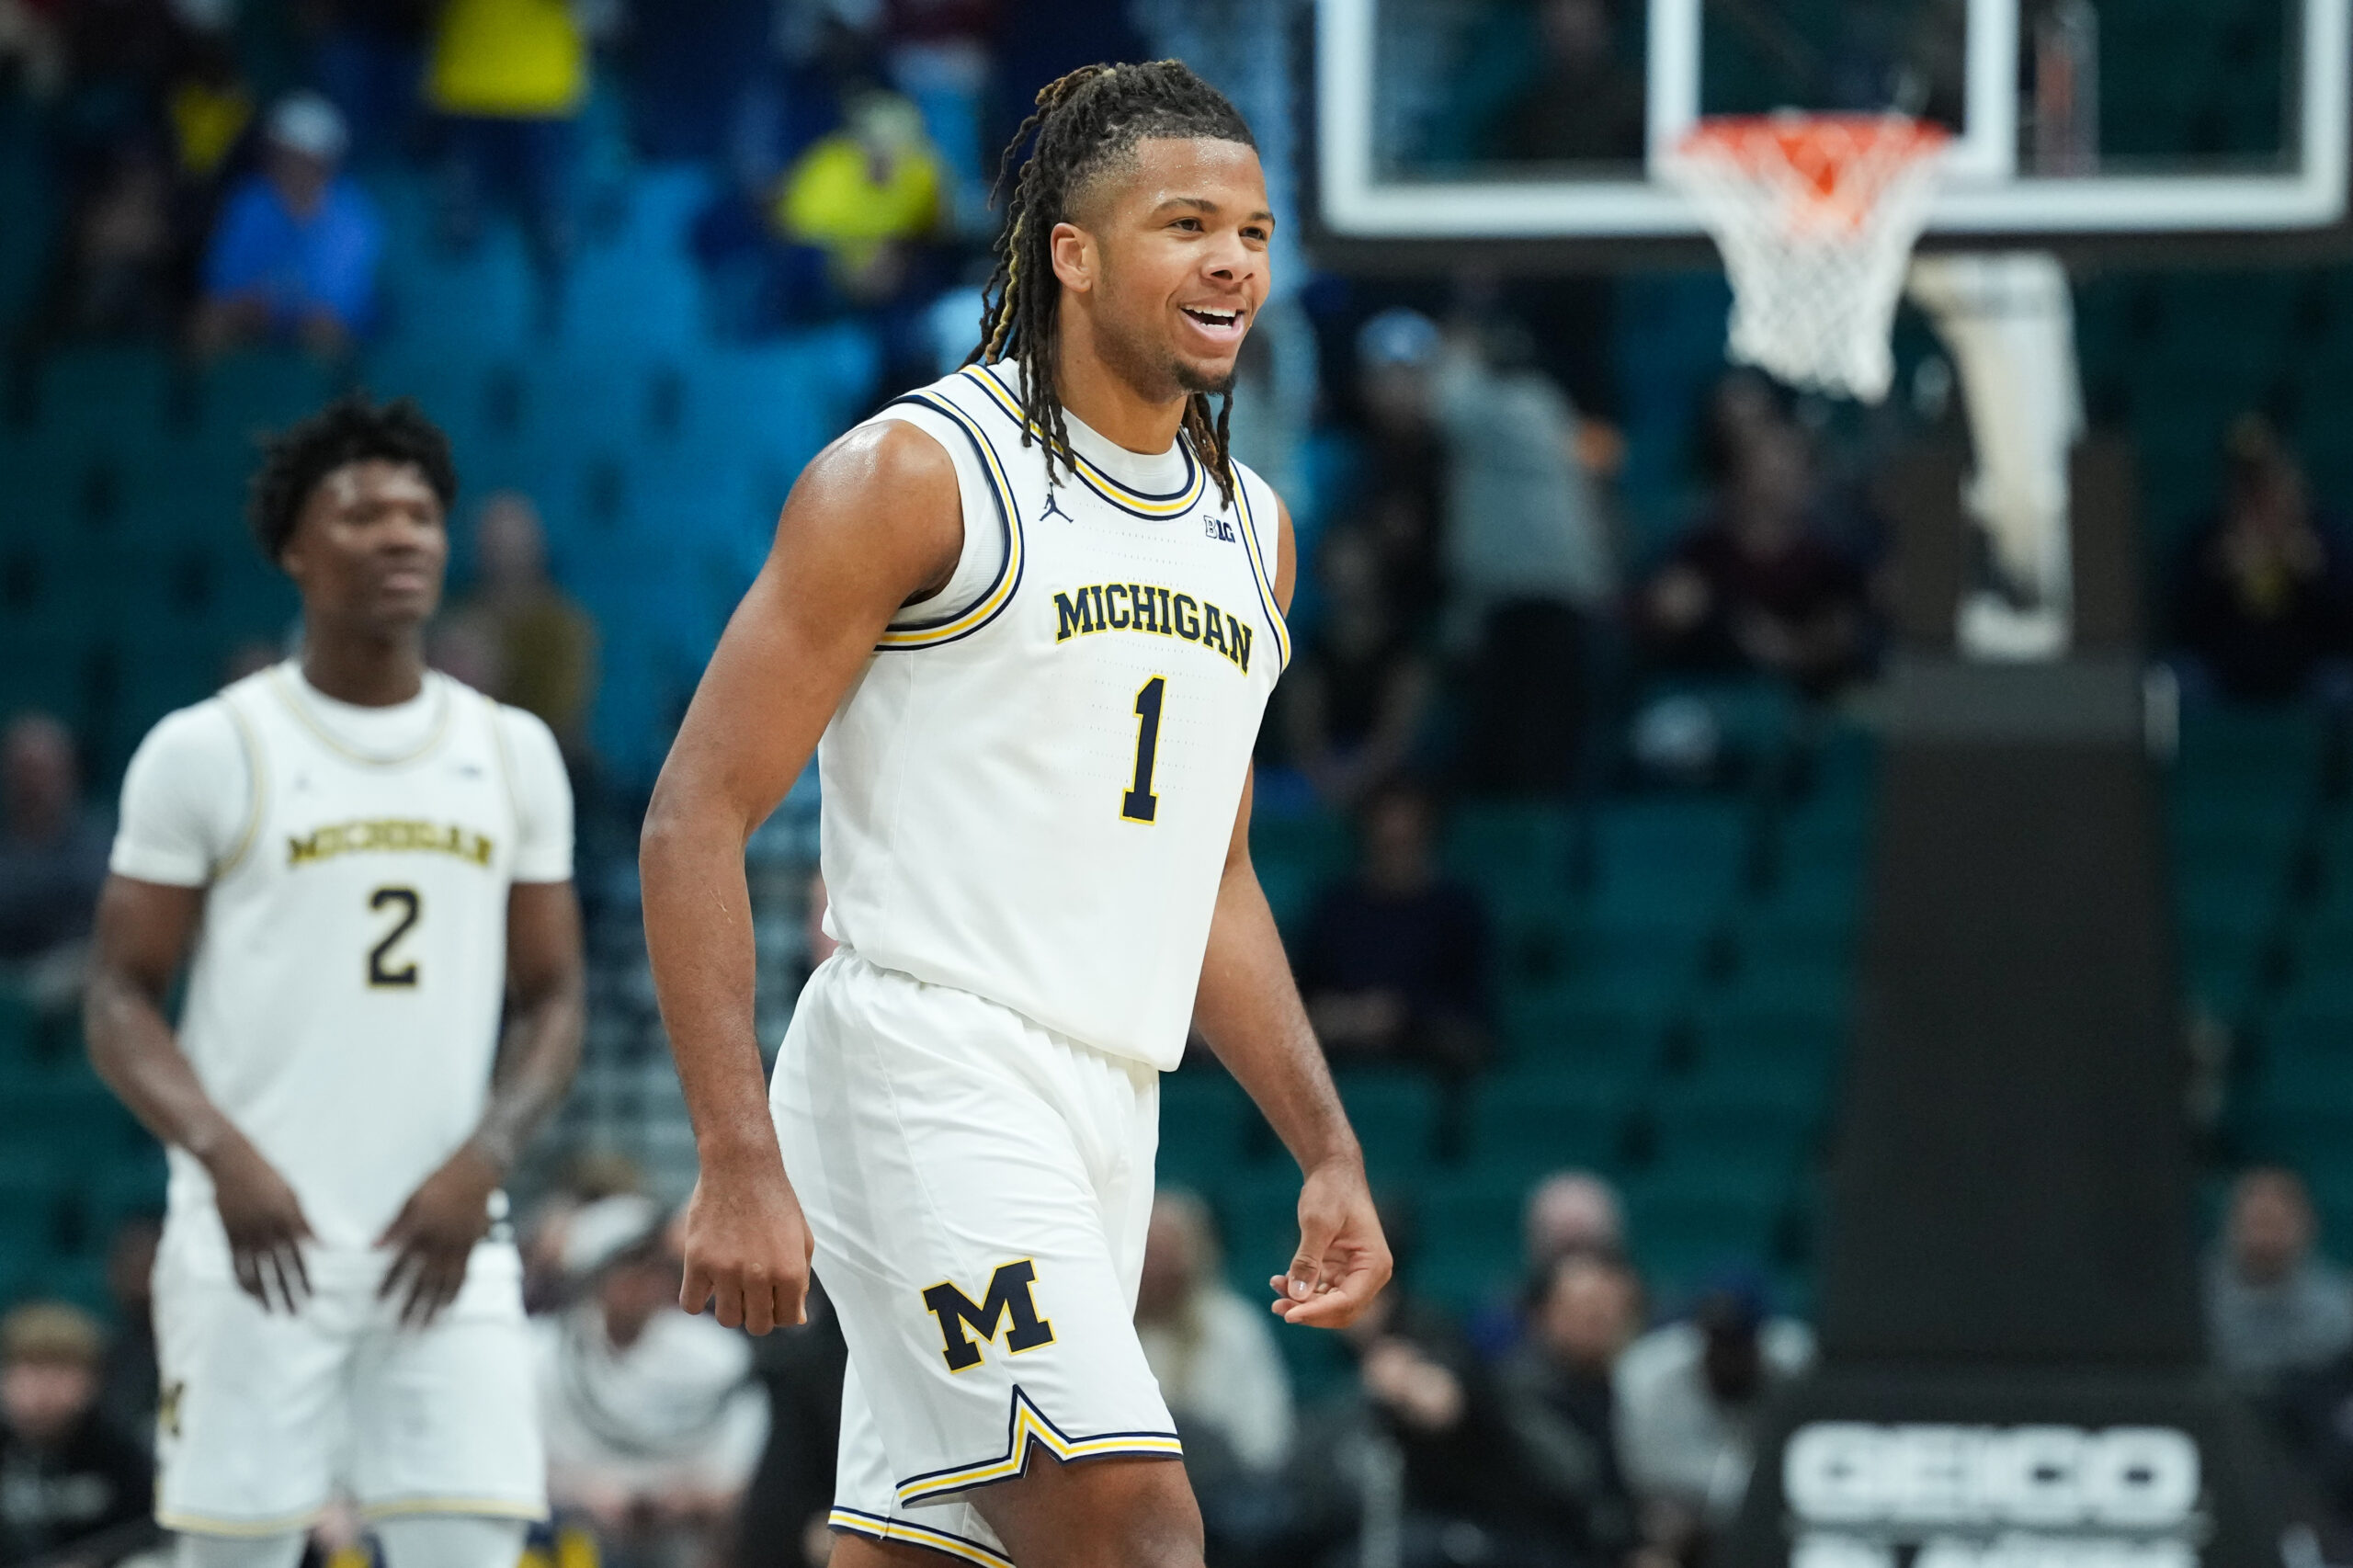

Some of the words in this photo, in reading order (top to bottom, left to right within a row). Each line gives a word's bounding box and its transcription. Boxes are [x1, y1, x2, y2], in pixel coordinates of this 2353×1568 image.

[1052, 584, 1253, 676] MICHIGAN
[1120, 674, 1166, 825] 1
[366, 886, 422, 989] 2
[920, 1256, 1057, 1374] M
